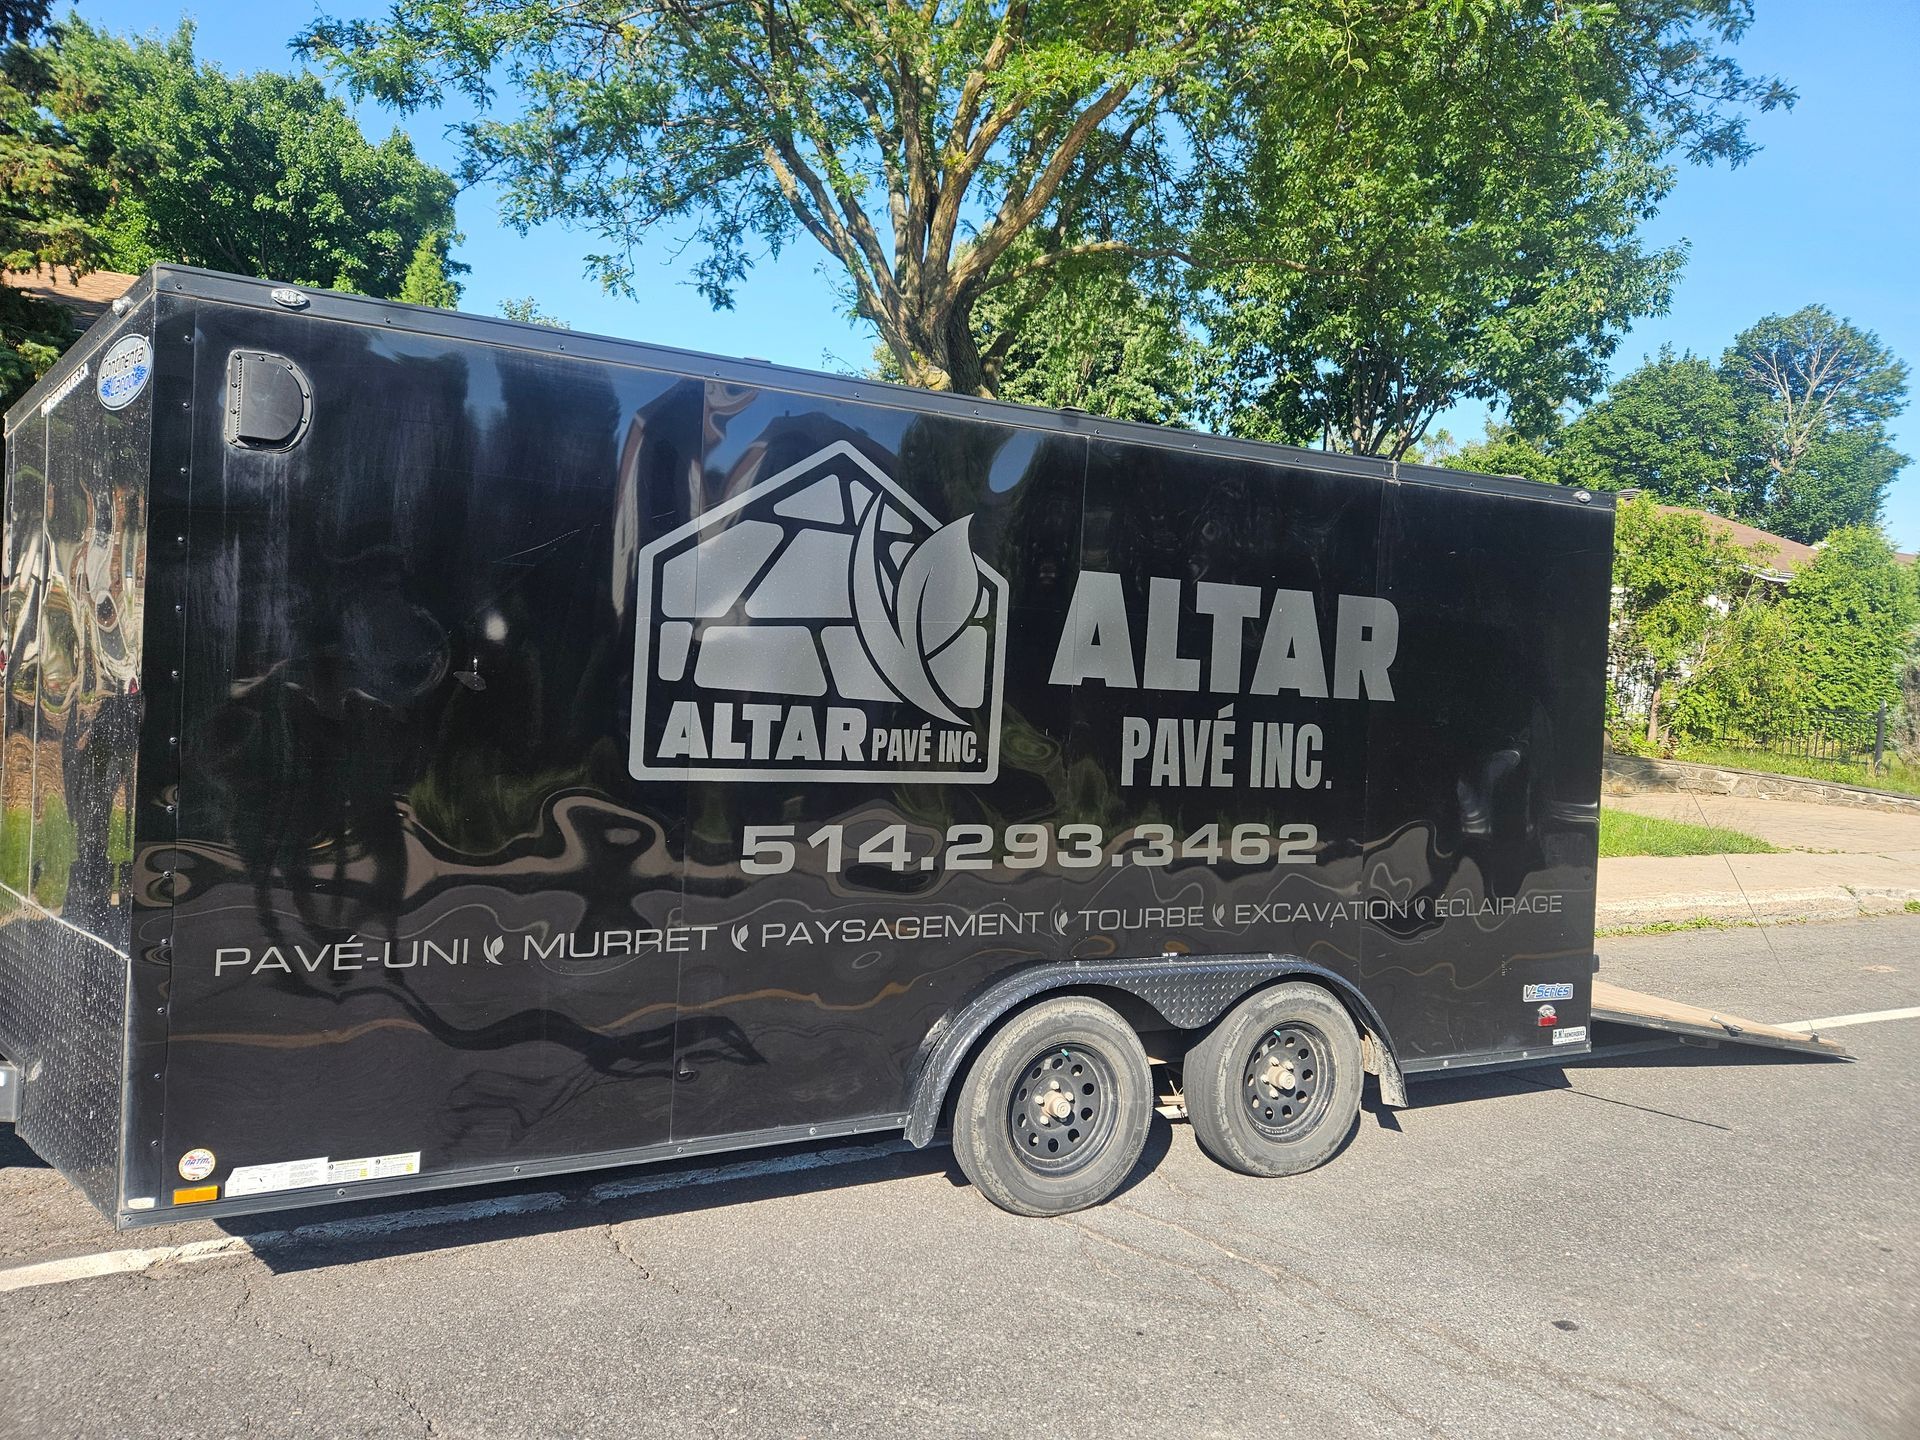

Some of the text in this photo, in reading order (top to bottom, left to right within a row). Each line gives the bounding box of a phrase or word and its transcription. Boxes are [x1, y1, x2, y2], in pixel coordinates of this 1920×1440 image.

[100, 336, 150, 380] Continental
[109, 372, 135, 399] Cargo
[1048, 570, 1399, 702] ALTAR
[656, 700, 983, 763] ALTAR PAVÉ INC.
[1121, 703, 1333, 790] PAVÉ INC.
[740, 823, 1319, 875] 514.293.3462
[214, 935, 470, 977] PAVÉ-UNI
[522, 926, 718, 961] MURRET
[761, 911, 1044, 947] PAYSAGEMENT
[1078, 905, 1204, 931] TOURBE
[1234, 899, 1409, 925] EXCAVATION
